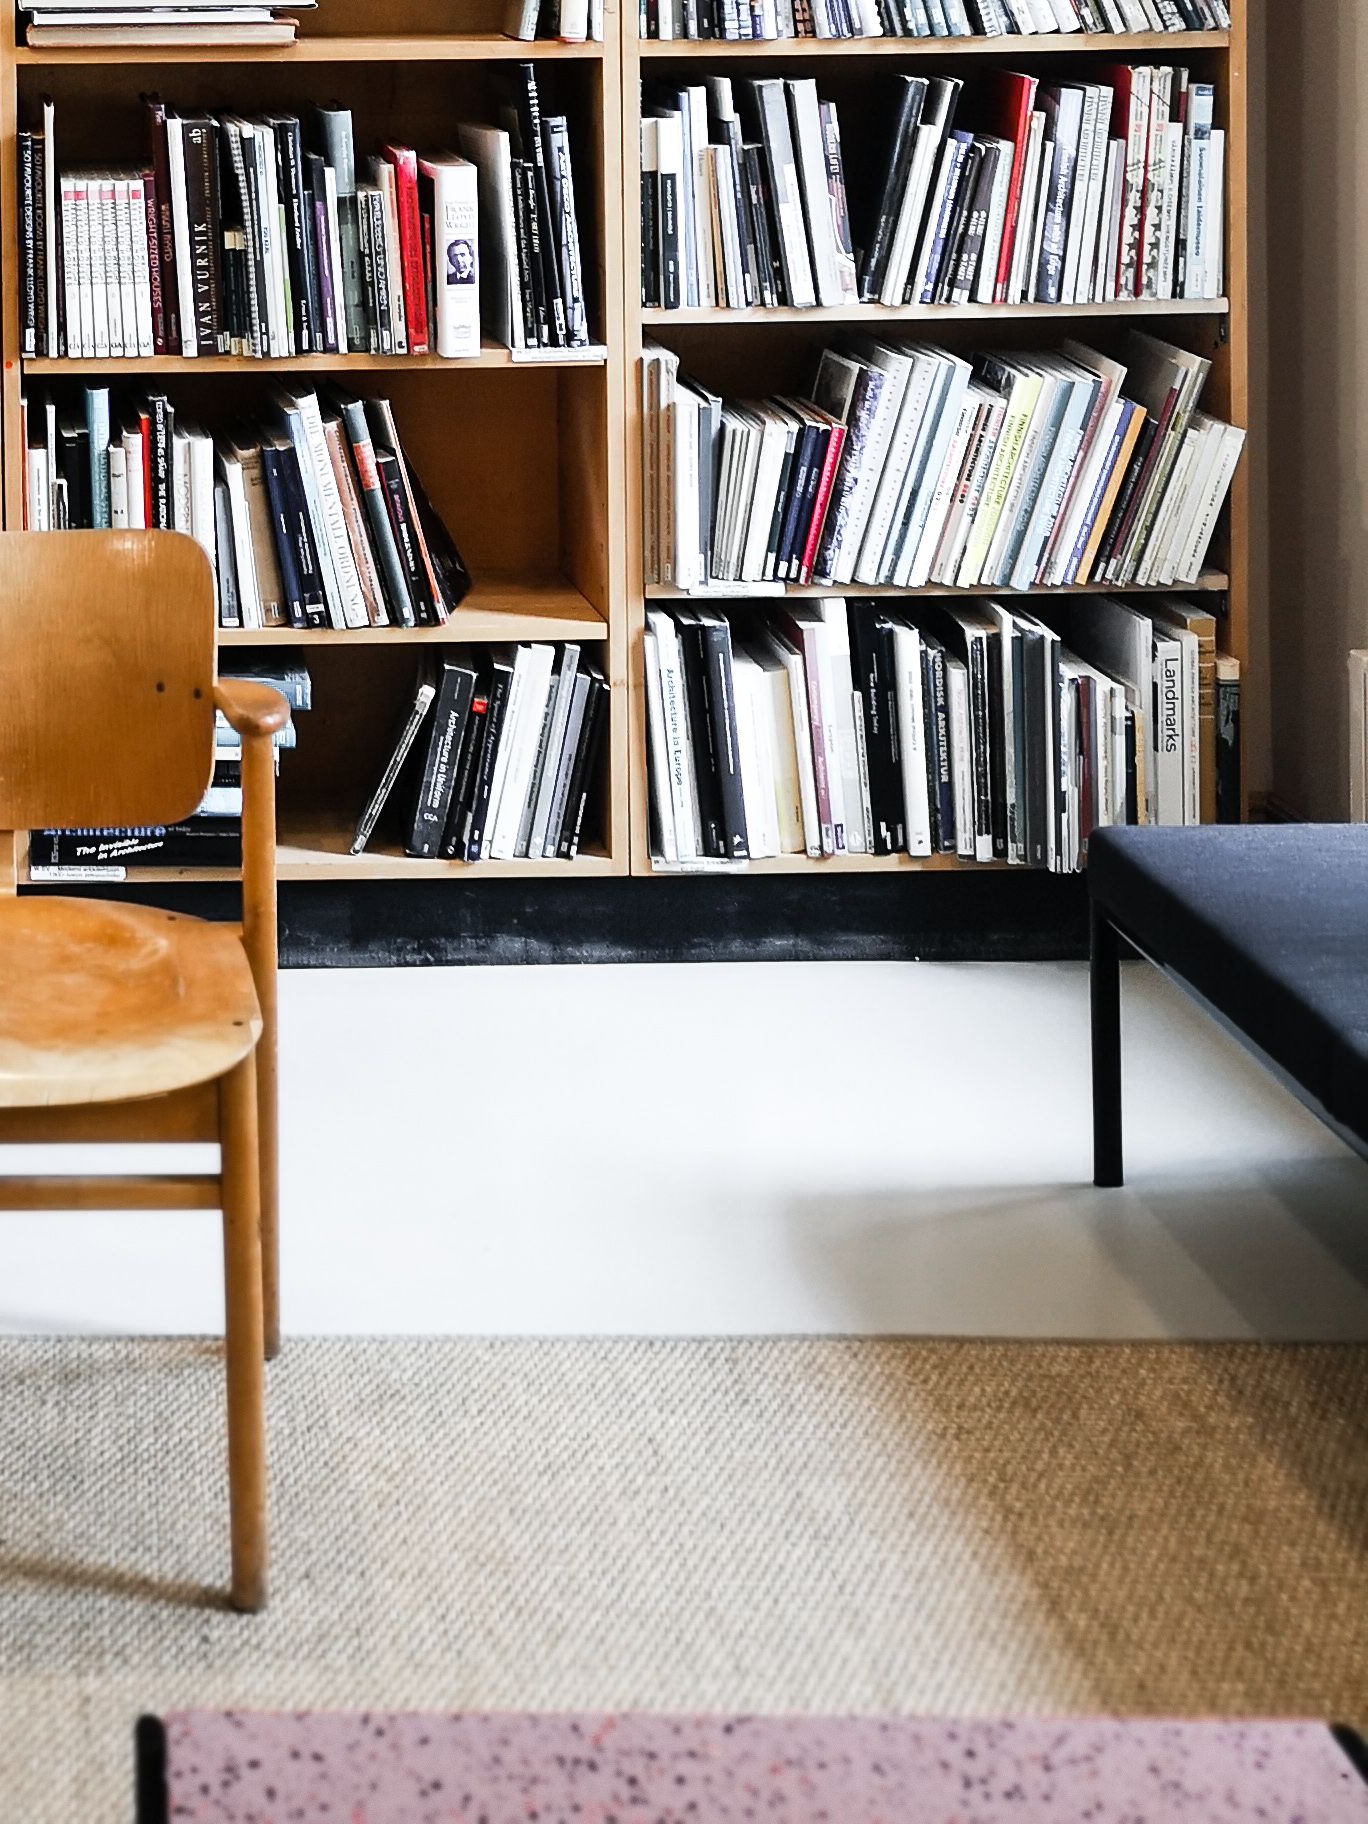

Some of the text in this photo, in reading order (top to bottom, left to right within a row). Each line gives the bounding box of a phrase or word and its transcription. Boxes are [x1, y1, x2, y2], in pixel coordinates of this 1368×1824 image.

[1053, 176, 1068, 224] Architecture
[146, 198, 162, 308] WRIGHT-SIZED HOUSES
[194, 223, 214, 346] IVAN VURNIK
[1048, 256, 1060, 276] Edge
[993, 414, 1029, 506] FINNISH ARCHITECTURE
[934, 652, 949, 783] NORDISK ARKITEKTUR
[1164, 658, 1180, 752] Landmarks
